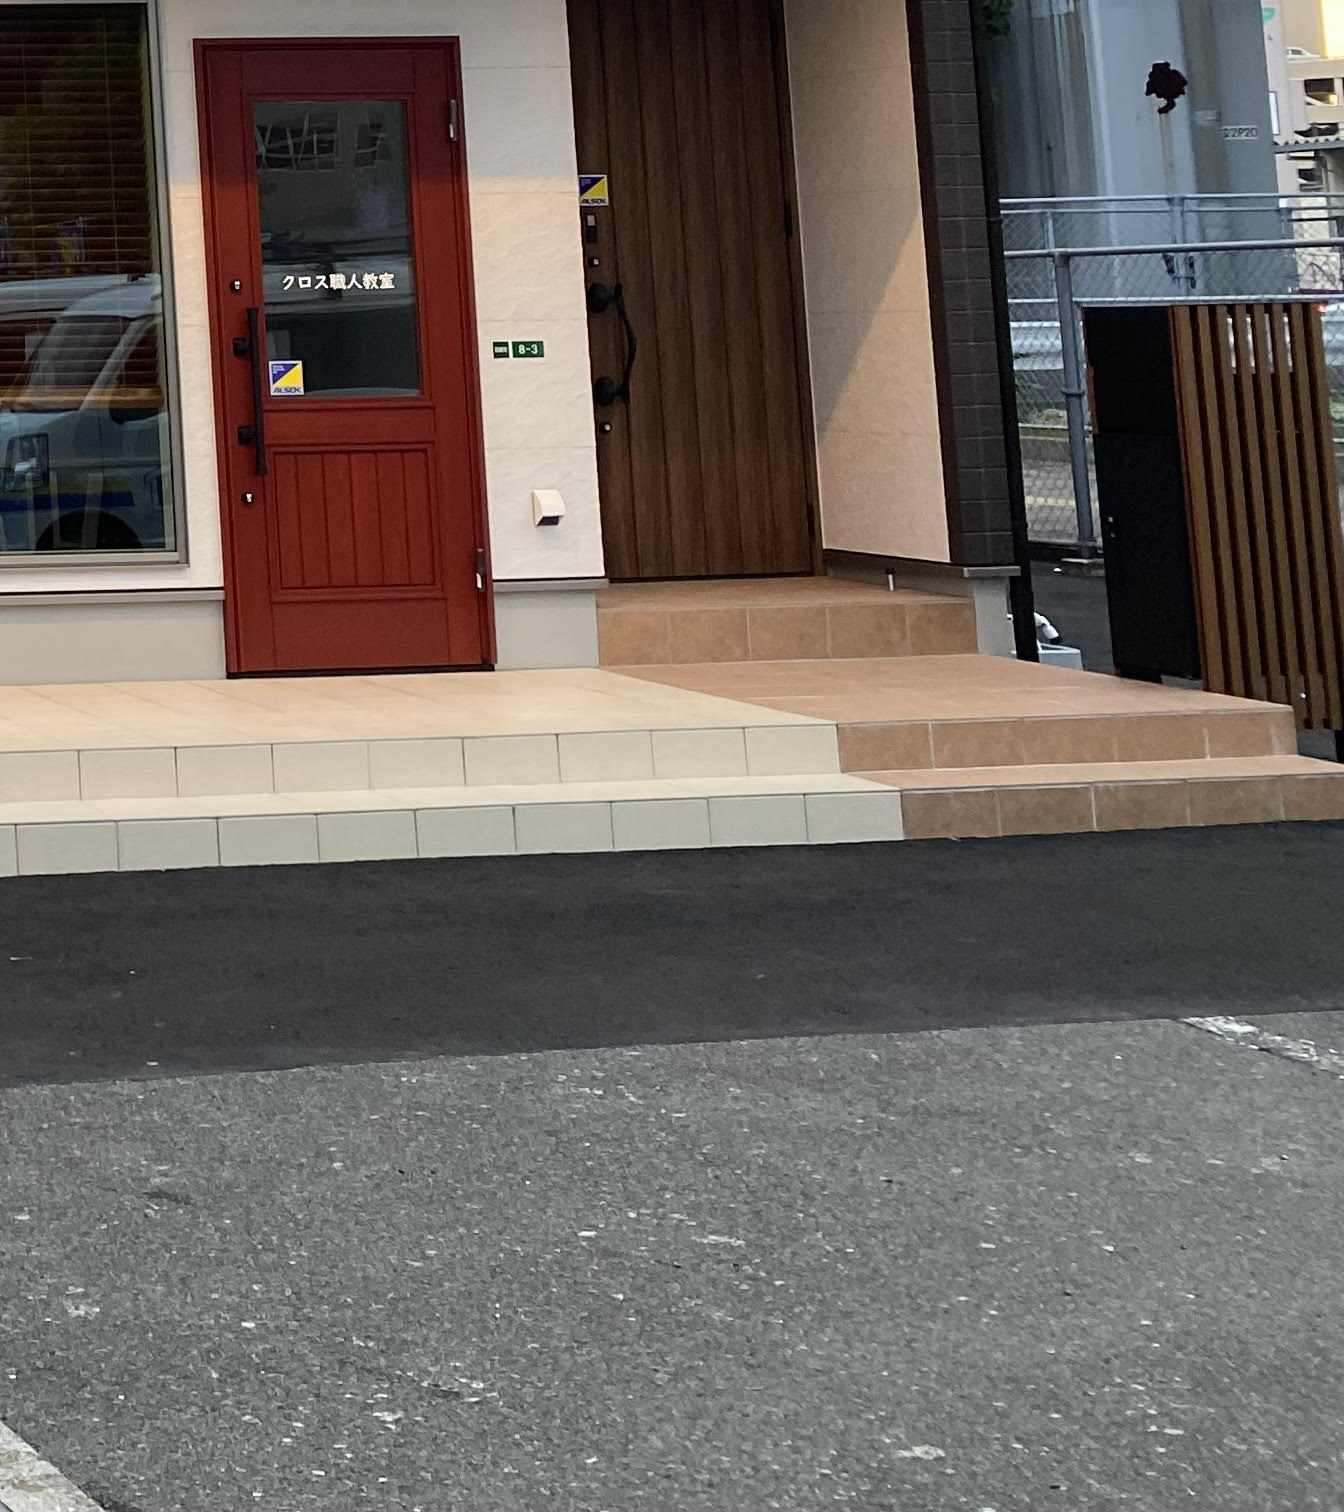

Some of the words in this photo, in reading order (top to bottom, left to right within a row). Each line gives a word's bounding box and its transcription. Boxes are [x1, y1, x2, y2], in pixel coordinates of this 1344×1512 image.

[282, 272, 395, 290] クロス職人教室
[518, 343, 538, 355] 8-3
